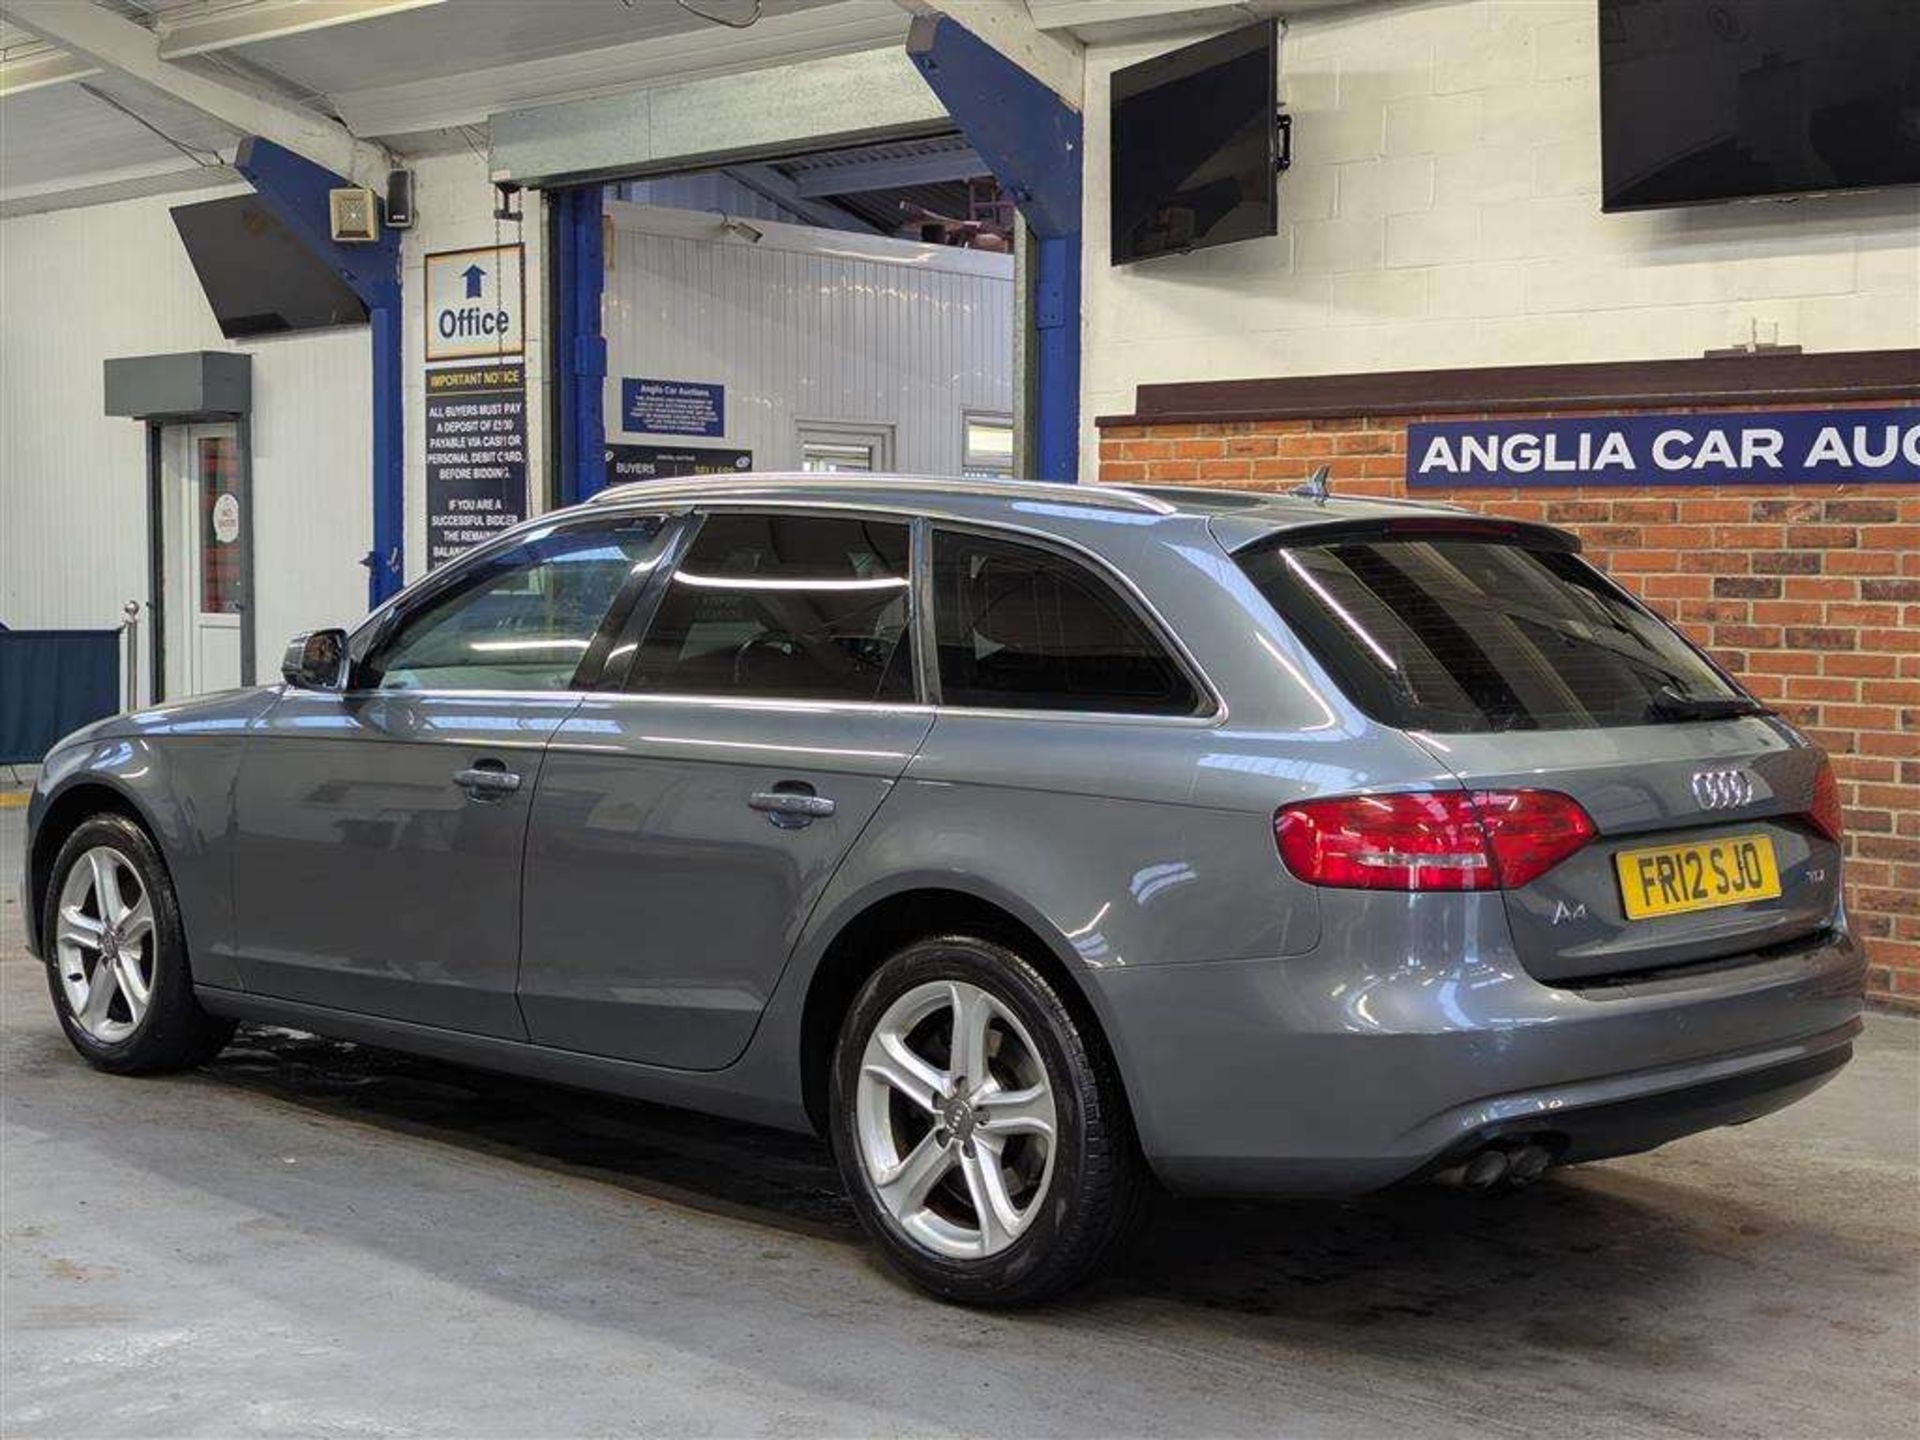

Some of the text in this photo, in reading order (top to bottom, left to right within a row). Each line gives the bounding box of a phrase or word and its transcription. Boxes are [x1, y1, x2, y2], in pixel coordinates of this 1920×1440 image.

[439, 306, 509, 338] Office
[430, 372, 482, 387] IMPORTANT
[664, 386, 678, 395] Car
[429, 402, 521, 418] ALL BUYERS MUST PAY
[436, 422, 443, 433] A
[444, 421, 479, 433] DEPOSIT
[480, 420, 491, 431] OF
[429, 436, 466, 449] PAYABLE
[467, 436, 482, 447] VIA
[507, 434, 522, 446] OR
[1418, 431, 1637, 474] ANGLIA
[1652, 427, 1784, 471] CAR
[427, 452, 470, 464] PERSONAL
[470, 451, 496, 463] DEBIT
[439, 468, 472, 480] BEFORE
[616, 462, 655, 475] BUYERS
[448, 498, 502, 511] IF YOU ARE A
[432, 515, 519, 526] SUCCESSFUL BIDDER
[444, 530, 460, 542] THE
[1637, 843, 1764, 907] FR12 SJO
[1552, 900, 1587, 926] A4
